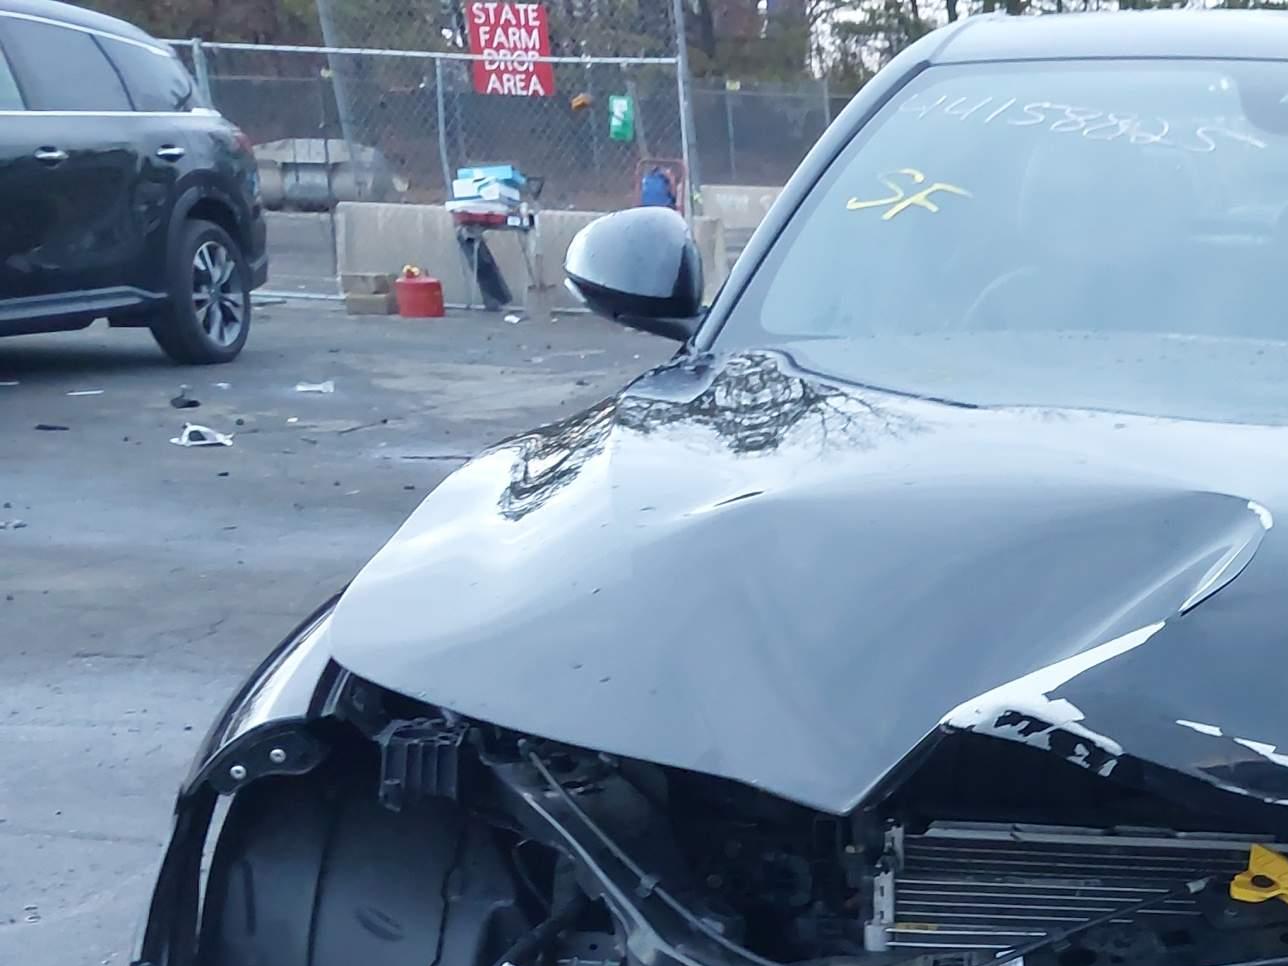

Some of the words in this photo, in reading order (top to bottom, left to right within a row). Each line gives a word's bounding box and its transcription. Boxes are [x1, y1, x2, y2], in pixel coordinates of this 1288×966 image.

[472, 2, 540, 26] STATE
[479, 26, 540, 49] FARM
[482, 48, 540, 72] DROP
[486, 72, 545, 96] AREA
